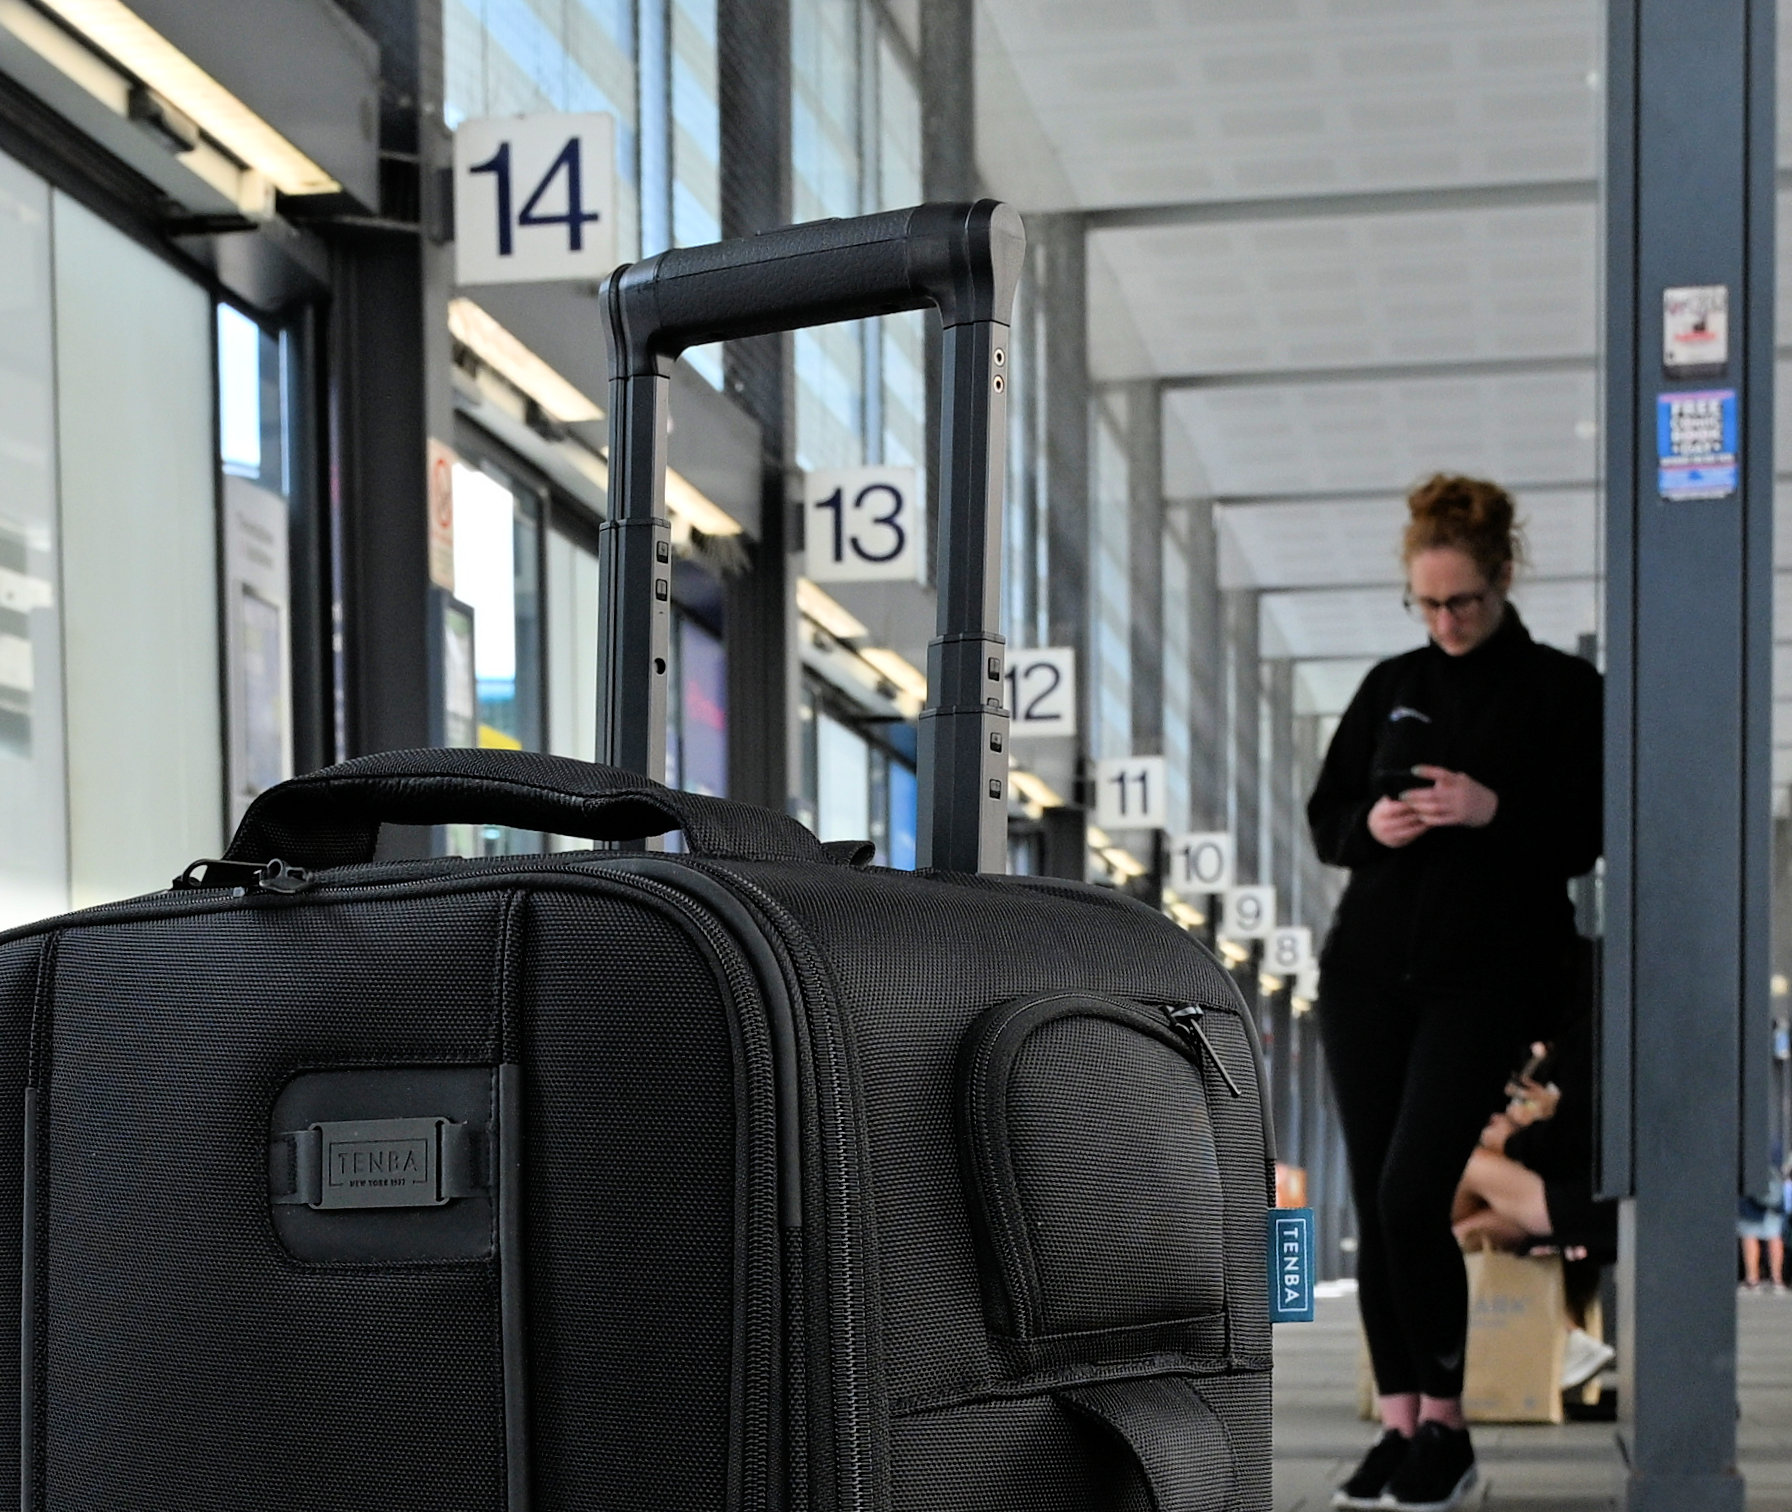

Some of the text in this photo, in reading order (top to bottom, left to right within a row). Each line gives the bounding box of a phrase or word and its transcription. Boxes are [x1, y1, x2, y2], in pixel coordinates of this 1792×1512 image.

[469, 136, 599, 256] 14
[814, 484, 905, 562] 13
[1005, 661, 1062, 722] 12
[1110, 771, 1148, 816] 11
[1178, 841, 1224, 884] 10
[1236, 895, 1262, 931] 9
[1275, 935, 1298, 968] 8
[338, 1150, 417, 1174] TENBA
[349, 1179, 366, 1188] NEW
[368, 1178, 389, 1188] YORK
[1283, 1227, 1300, 1304] TENBA
